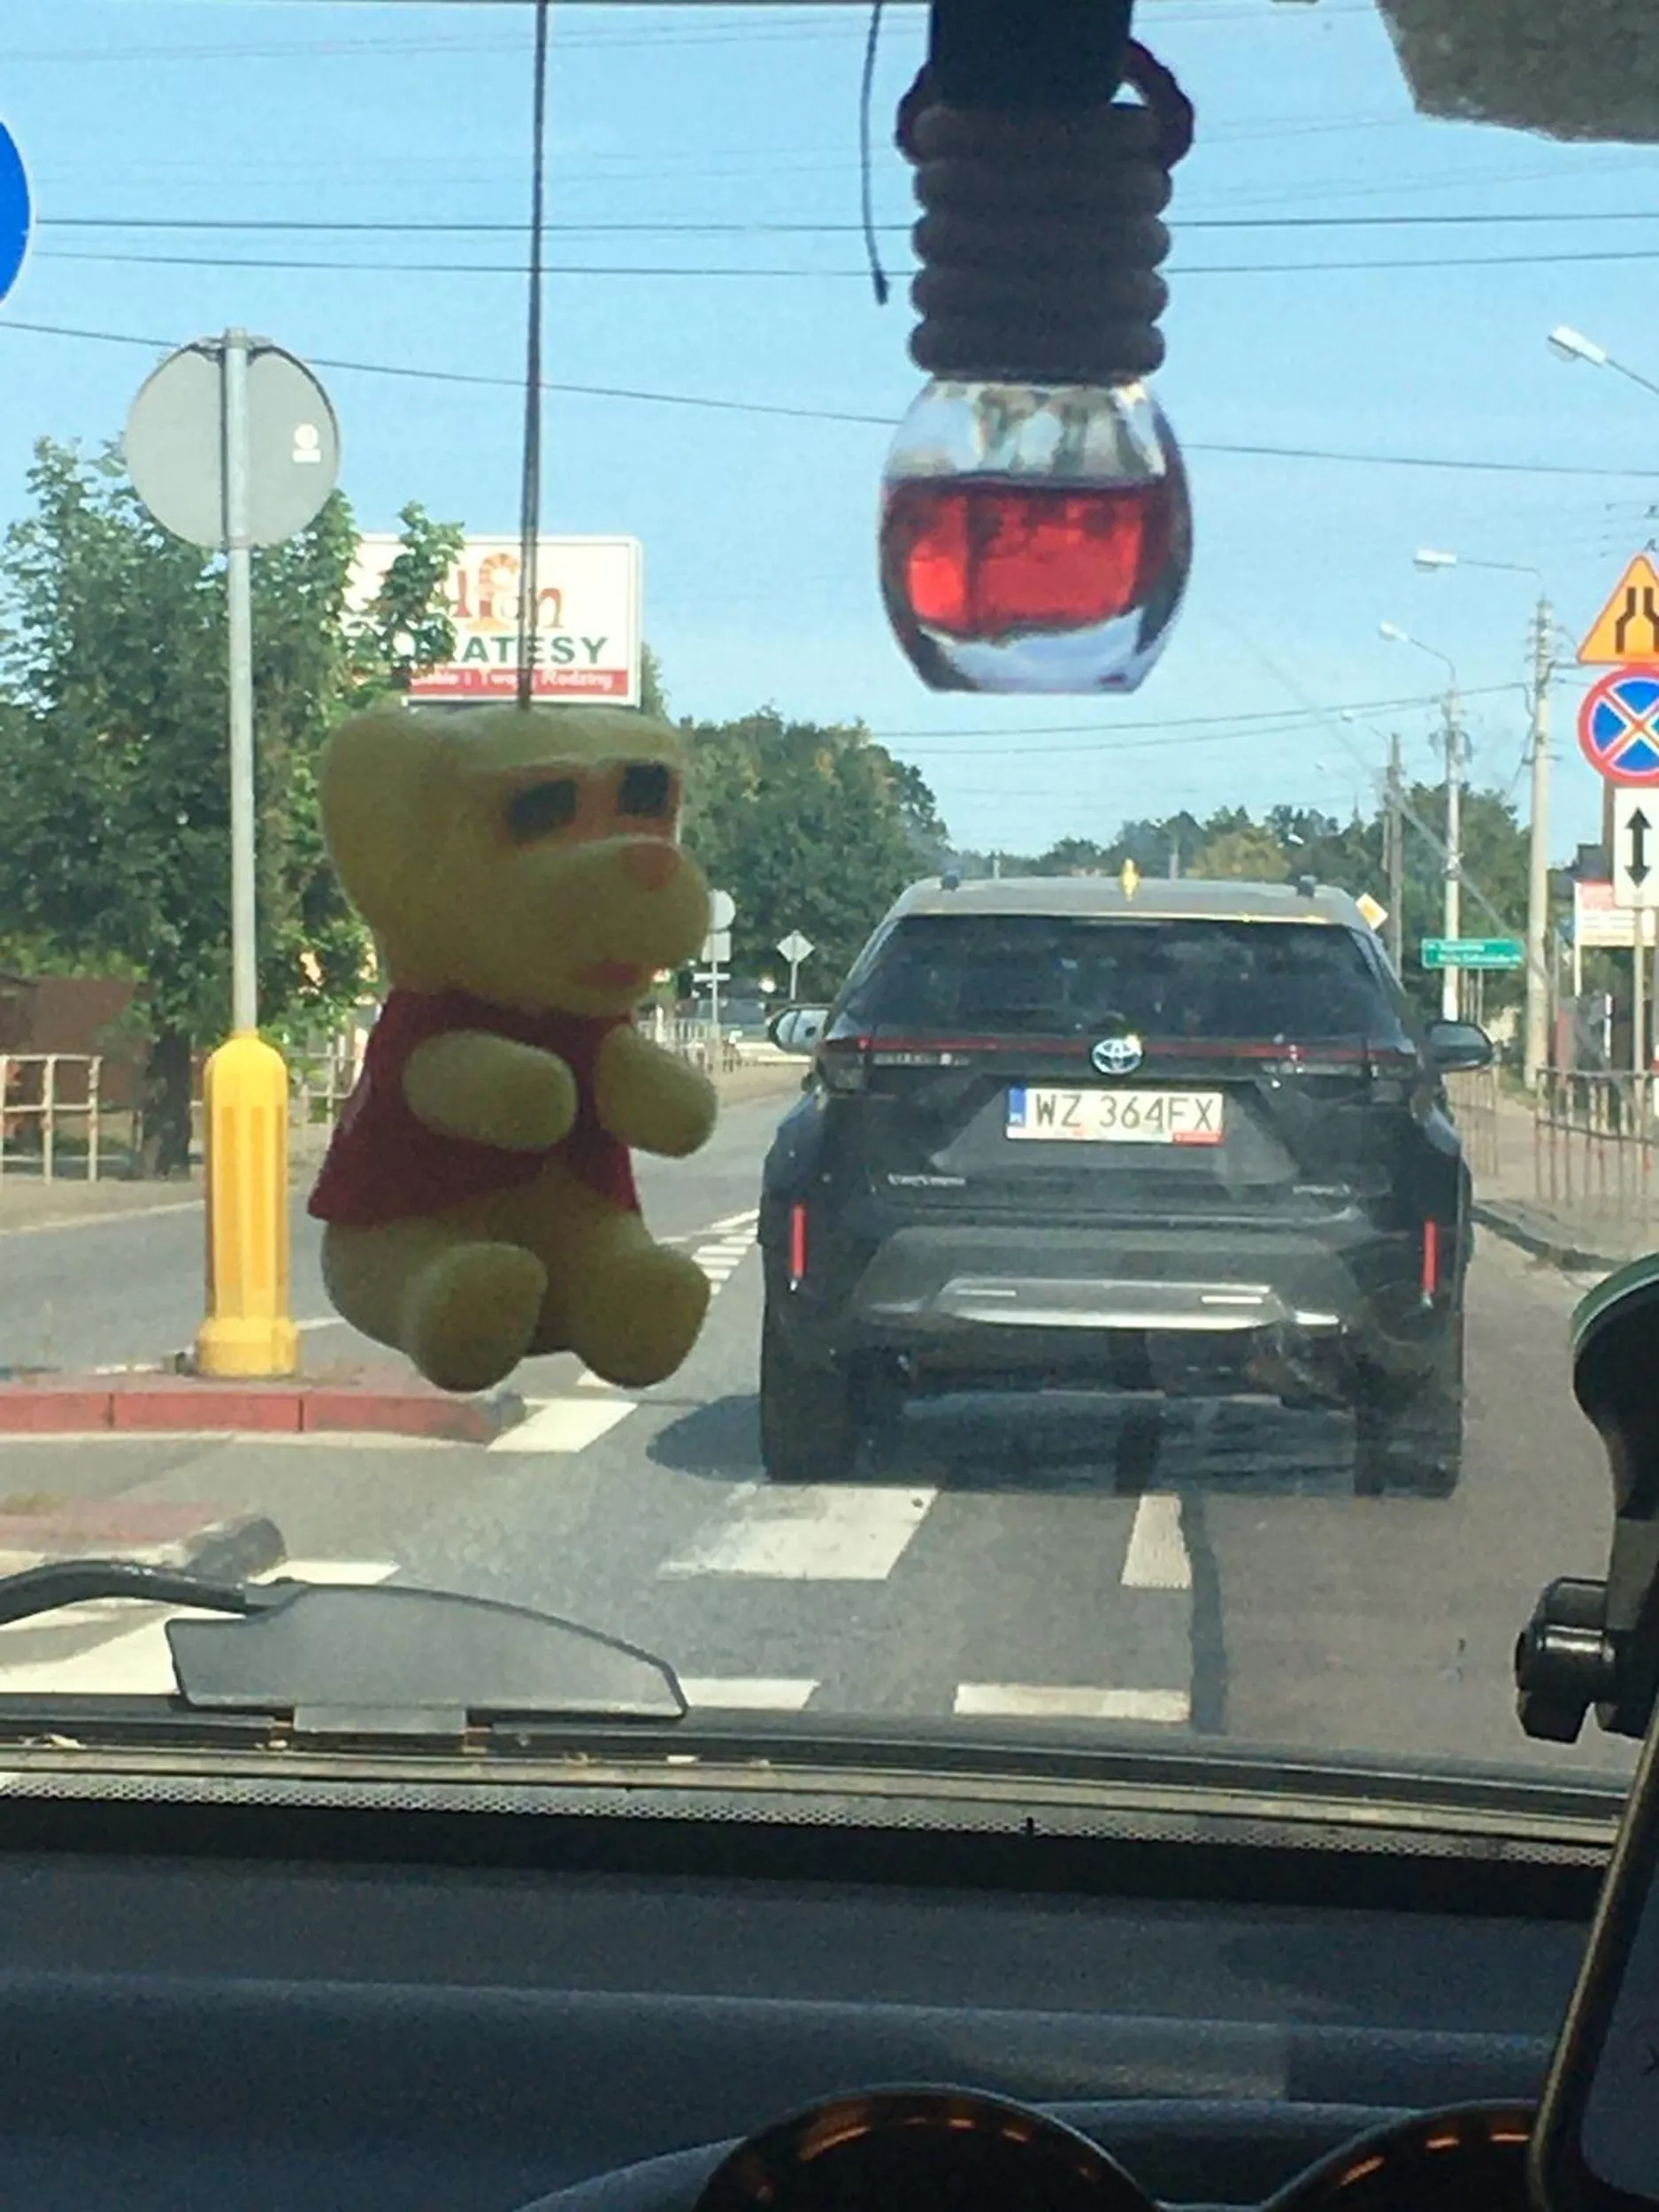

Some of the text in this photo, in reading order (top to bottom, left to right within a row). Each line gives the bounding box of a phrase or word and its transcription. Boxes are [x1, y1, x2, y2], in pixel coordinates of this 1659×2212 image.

[451, 635, 608, 665] ATESY
[1035, 1093, 1214, 1131] WZ 364FX
